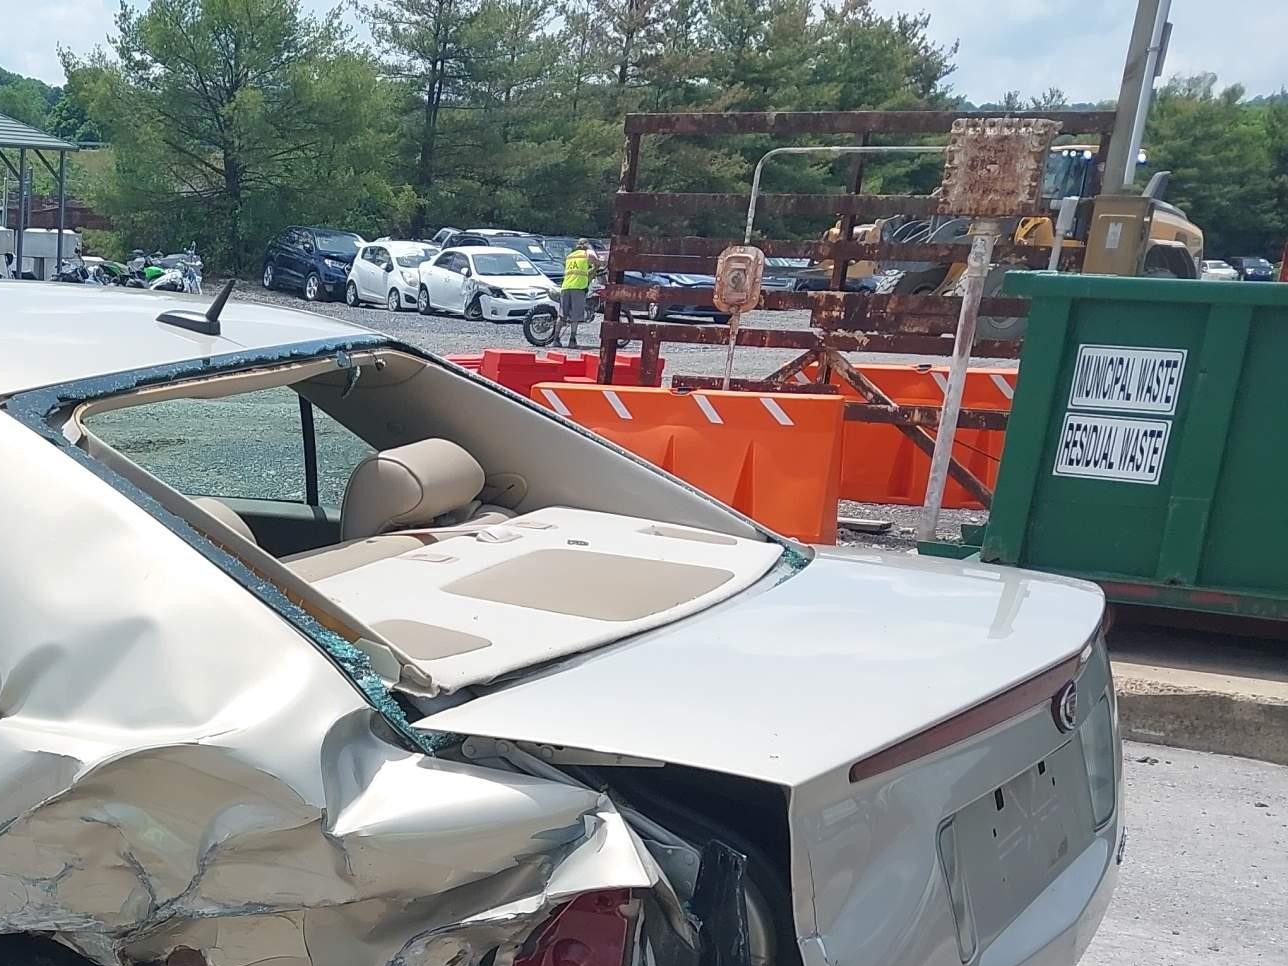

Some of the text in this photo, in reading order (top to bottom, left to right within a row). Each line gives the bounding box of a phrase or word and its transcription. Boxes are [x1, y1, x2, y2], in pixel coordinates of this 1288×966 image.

[1076, 354, 1179, 404] MUNICIPAL WASTE
[1060, 422, 1163, 474] RESIDUAL WASTE
